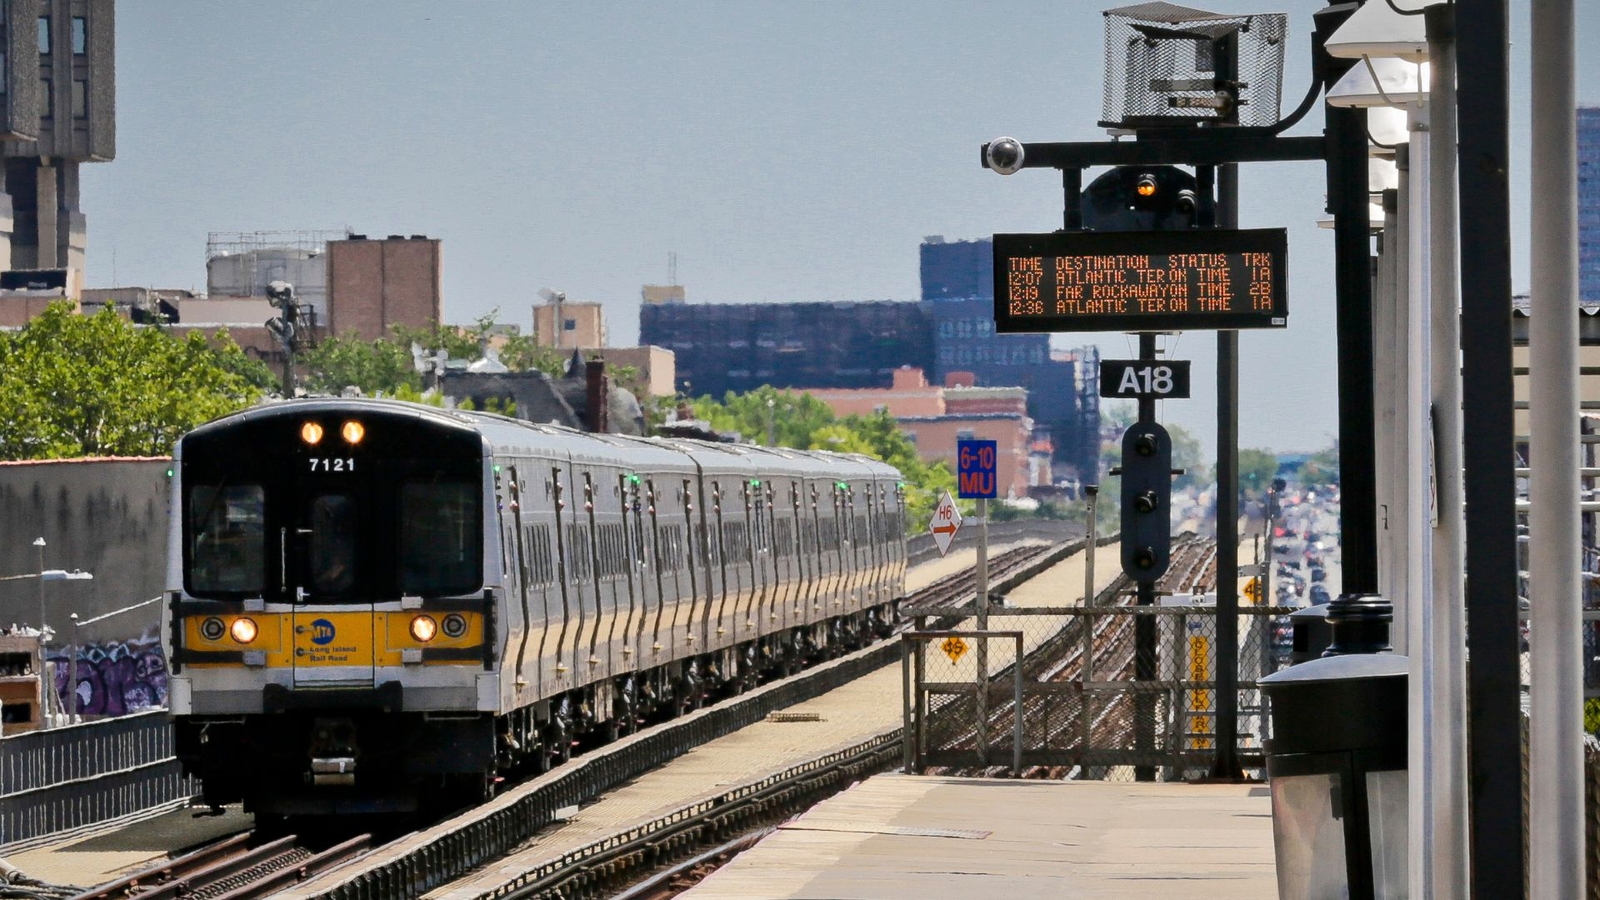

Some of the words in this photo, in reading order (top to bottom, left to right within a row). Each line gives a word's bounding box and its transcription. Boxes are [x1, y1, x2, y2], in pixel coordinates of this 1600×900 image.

[1009, 257, 1043, 271] TIME
[1055, 255, 1149, 270] DESTINATION
[1168, 254, 1227, 268] STATUS
[1241, 253, 1271, 267] TRK
[1008, 272, 1043, 285] 12:07
[1056, 270, 1127, 285] ATLANTIC
[1136, 269, 1165, 283] TER
[1169, 269, 1187, 282] ON
[1197, 268, 1231, 282] TIME
[1252, 267, 1271, 281] 1A
[1009, 286, 1039, 300] 12:19
[1056, 285, 1084, 299] FAR
[1092, 283, 1169, 299] ROCKAWAY
[1169, 283, 1188, 297] ON
[1249, 282, 1271, 295] 2B
[1009, 301, 1044, 315] 12:36
[1056, 299, 1127, 314] ATLANTIC
[1137, 298, 1166, 312] TER
[1169, 298, 1188, 312] ON
[1197, 297, 1232, 311] TIME
[1253, 296, 1272, 310] 1A
[1117, 365, 1174, 394] A18
[309, 458, 354, 472] 7121
[960, 446, 994, 470] 6-10
[960, 472, 994, 495] MU
[939, 504, 952, 521] H6
[309, 646, 330, 654] Long
